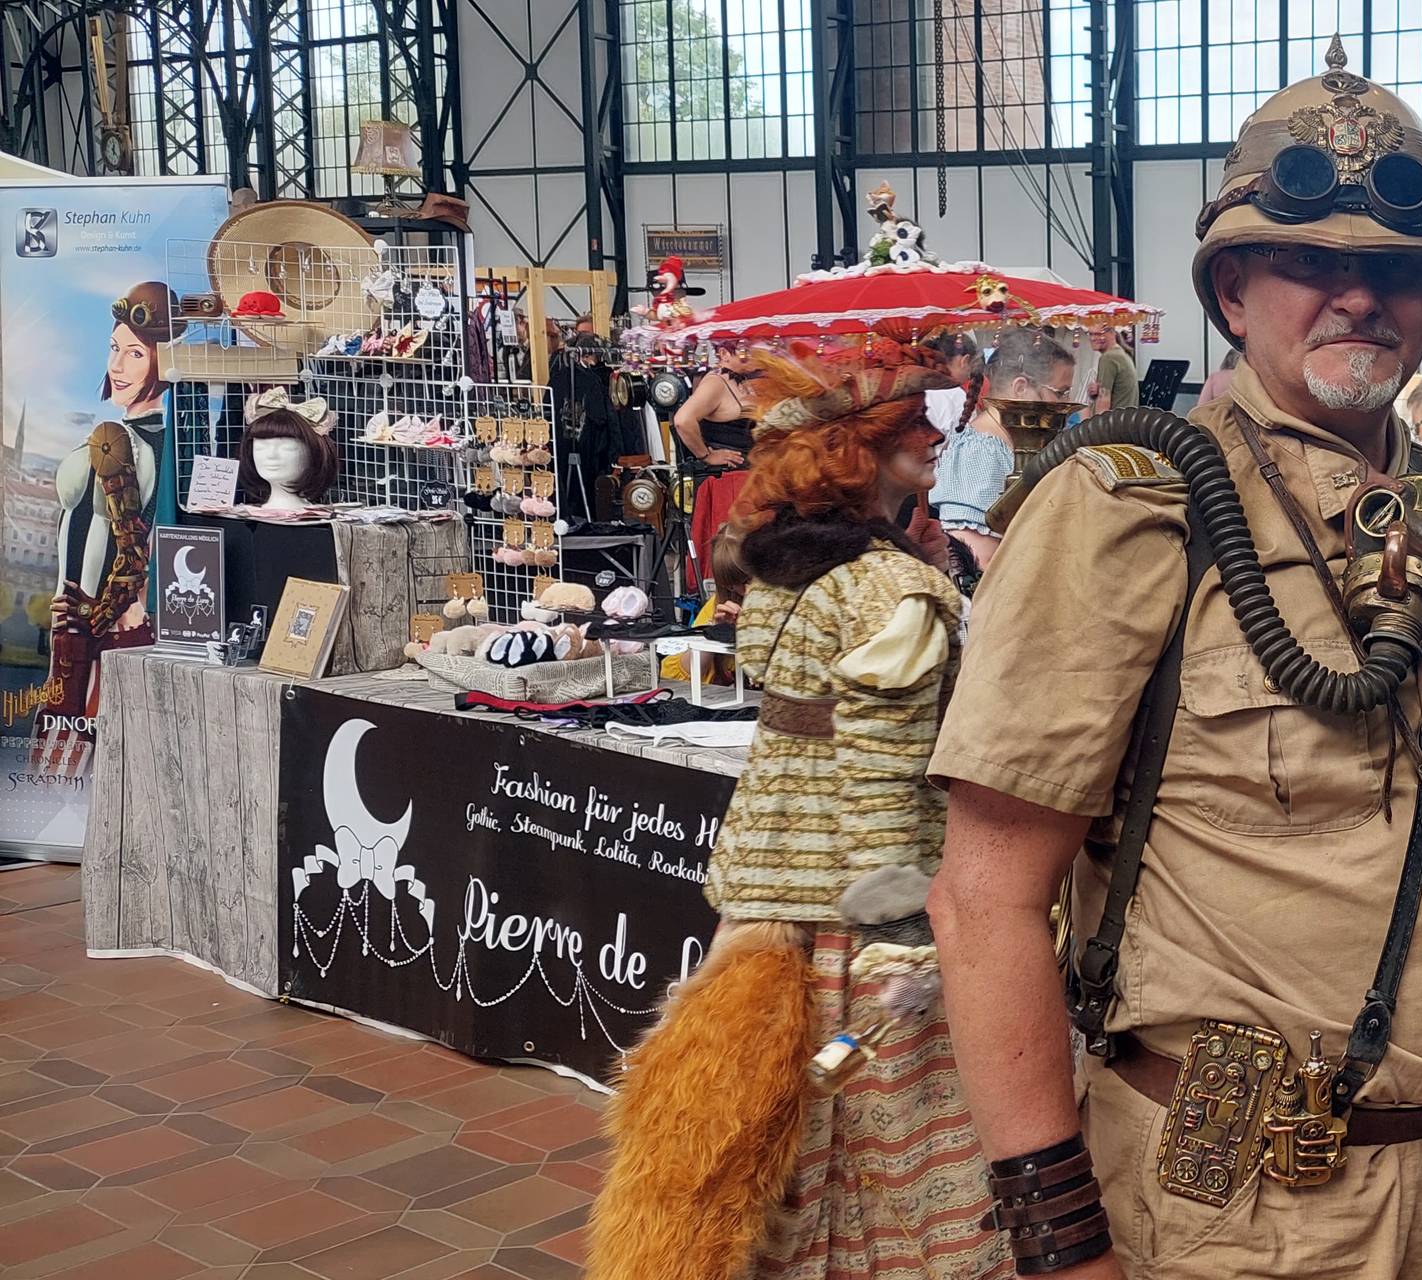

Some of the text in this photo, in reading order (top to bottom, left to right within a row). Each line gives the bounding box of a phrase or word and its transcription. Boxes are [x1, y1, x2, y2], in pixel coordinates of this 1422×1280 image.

[64, 210, 152, 227] Stephan Kuhn
[74, 245, 142, 253] www.stephan-kuhn.de
[466, 802, 503, 833] Gothic,
[510, 812, 588, 855] Steampunk,
[593, 836, 642, 869] Lolita,
[491, 761, 577, 814] Fashion
[584, 785, 623, 831] für
[623, 802, 686, 843] jedes
[457, 874, 583, 968] Pierre
[599, 912, 647, 990] de
